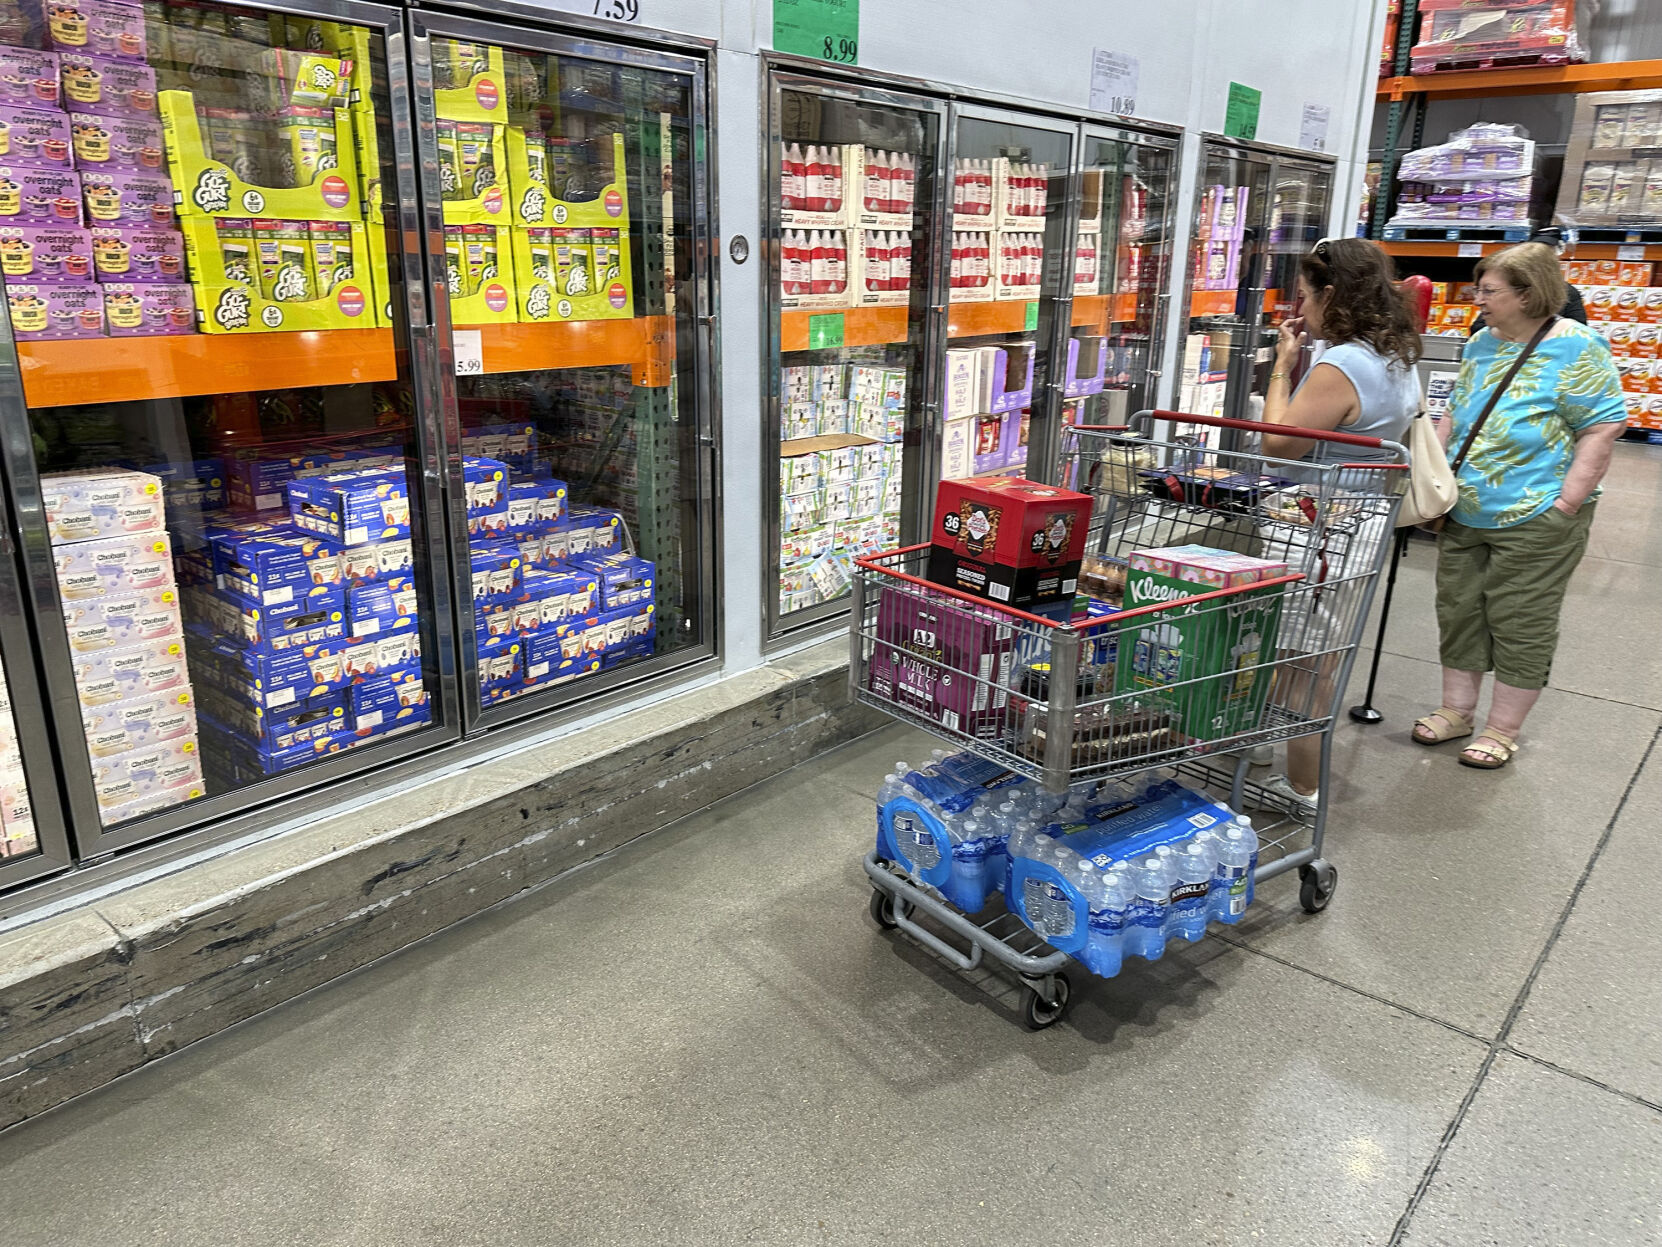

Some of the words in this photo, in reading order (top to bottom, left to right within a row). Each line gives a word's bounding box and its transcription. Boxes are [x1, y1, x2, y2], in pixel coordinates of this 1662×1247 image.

[823, 36, 857, 63] 8.99
[12, 115, 63, 129] overnight
[28, 127, 51, 136] oats
[113, 124, 158, 138] overnight
[126, 135, 147, 144] oats
[24, 175, 74, 188] overnight
[39, 185, 63, 195] oats
[123, 182, 168, 194] overnight
[137, 192, 157, 202] oats
[35, 235, 85, 246] overnight
[132, 235, 177, 246] overnight
[51, 243, 73, 253] oats
[145, 243, 166, 253] oats
[50, 291, 97, 301] overnight
[144, 290, 188, 299] overnight
[64, 299, 86, 308] oats
[157, 297, 178, 306] oats
[456, 361, 481, 373] 5.99
[92, 493, 121, 502] Chobani
[125, 508, 153, 517] Chobani
[63, 515, 92, 525] Chobani
[945, 515, 960, 529] 36
[1032, 533, 1044, 547] 36
[97, 551, 127, 562] Chobani
[383, 547, 408, 558] Chobani
[347, 553, 372, 564] Chobani
[132, 565, 160, 575] Chobani
[315, 562, 337, 572] Chobani
[957, 567, 987, 581] SEASONED
[66, 575, 97, 585] Chobani
[106, 602, 136, 613] Chobani
[269, 604, 299, 615] Chobani
[141, 615, 169, 626] Chobani
[78, 626, 107, 638] Chobani
[381, 642, 406, 653] Chobani
[347, 649, 373, 661] Chobani
[115, 656, 143, 667] Chobani
[316, 661, 339, 671] Chobani
[148, 667, 175, 678] Chobani
[903, 656, 938, 681] WHOLE
[86, 681, 114, 692] Chobani
[125, 706, 154, 718] Chobani
[158, 716, 186, 728] Chobani
[97, 732, 125, 743] Chobani
[131, 755, 159, 768] Chobani
[164, 764, 190, 777] Chobani
[103, 782, 132, 794] Chobani
[1097, 802, 1135, 819] KIRKLAND
[1097, 818, 1134, 837] purified
